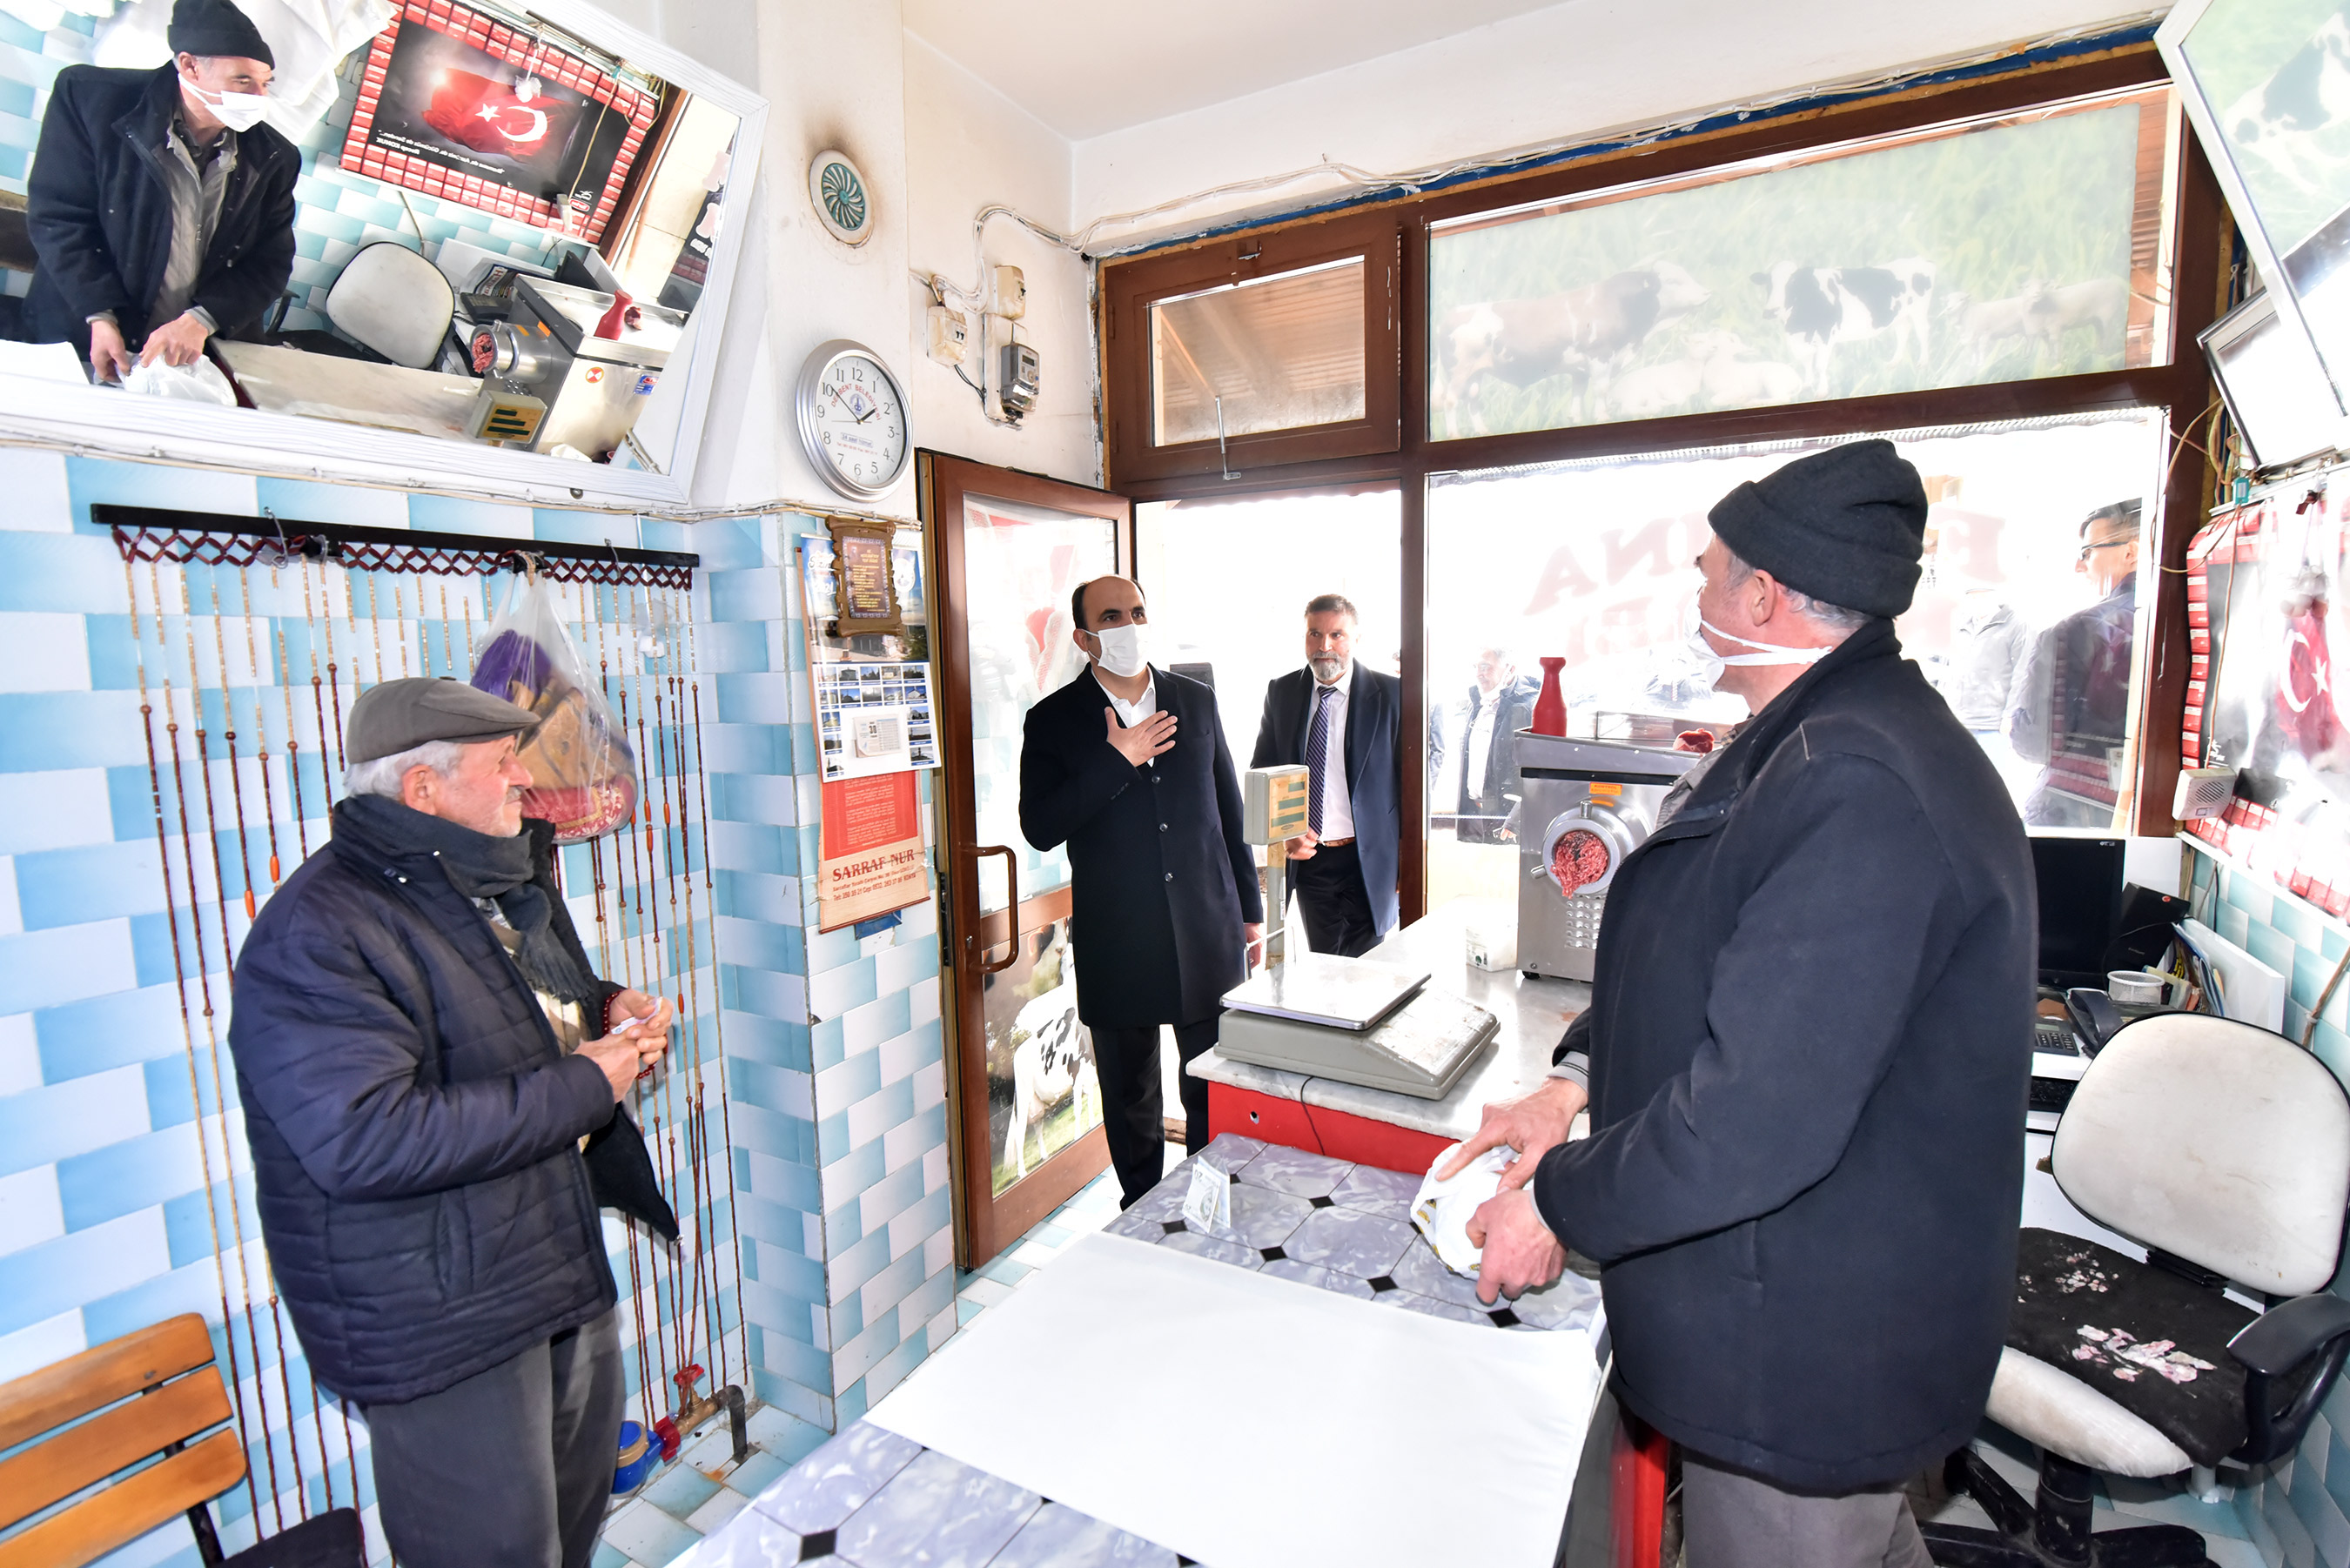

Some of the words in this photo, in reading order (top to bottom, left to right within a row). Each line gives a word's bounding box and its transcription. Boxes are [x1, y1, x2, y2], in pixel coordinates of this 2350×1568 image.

[836, 368, 844, 382] 11
[851, 367, 863, 382] 12
[822, 382, 834, 397] 10
[816, 405, 825, 418] 9
[883, 402, 890, 415] 2
[823, 432, 831, 445] 8
[888, 426, 895, 438] 3
[837, 452, 844, 466] 7
[883, 447, 890, 459] 4
[854, 463, 862, 476] 6
[870, 462, 878, 473] 5
[832, 856, 885, 881] SARRAF
[890, 849, 915, 867] NUR
